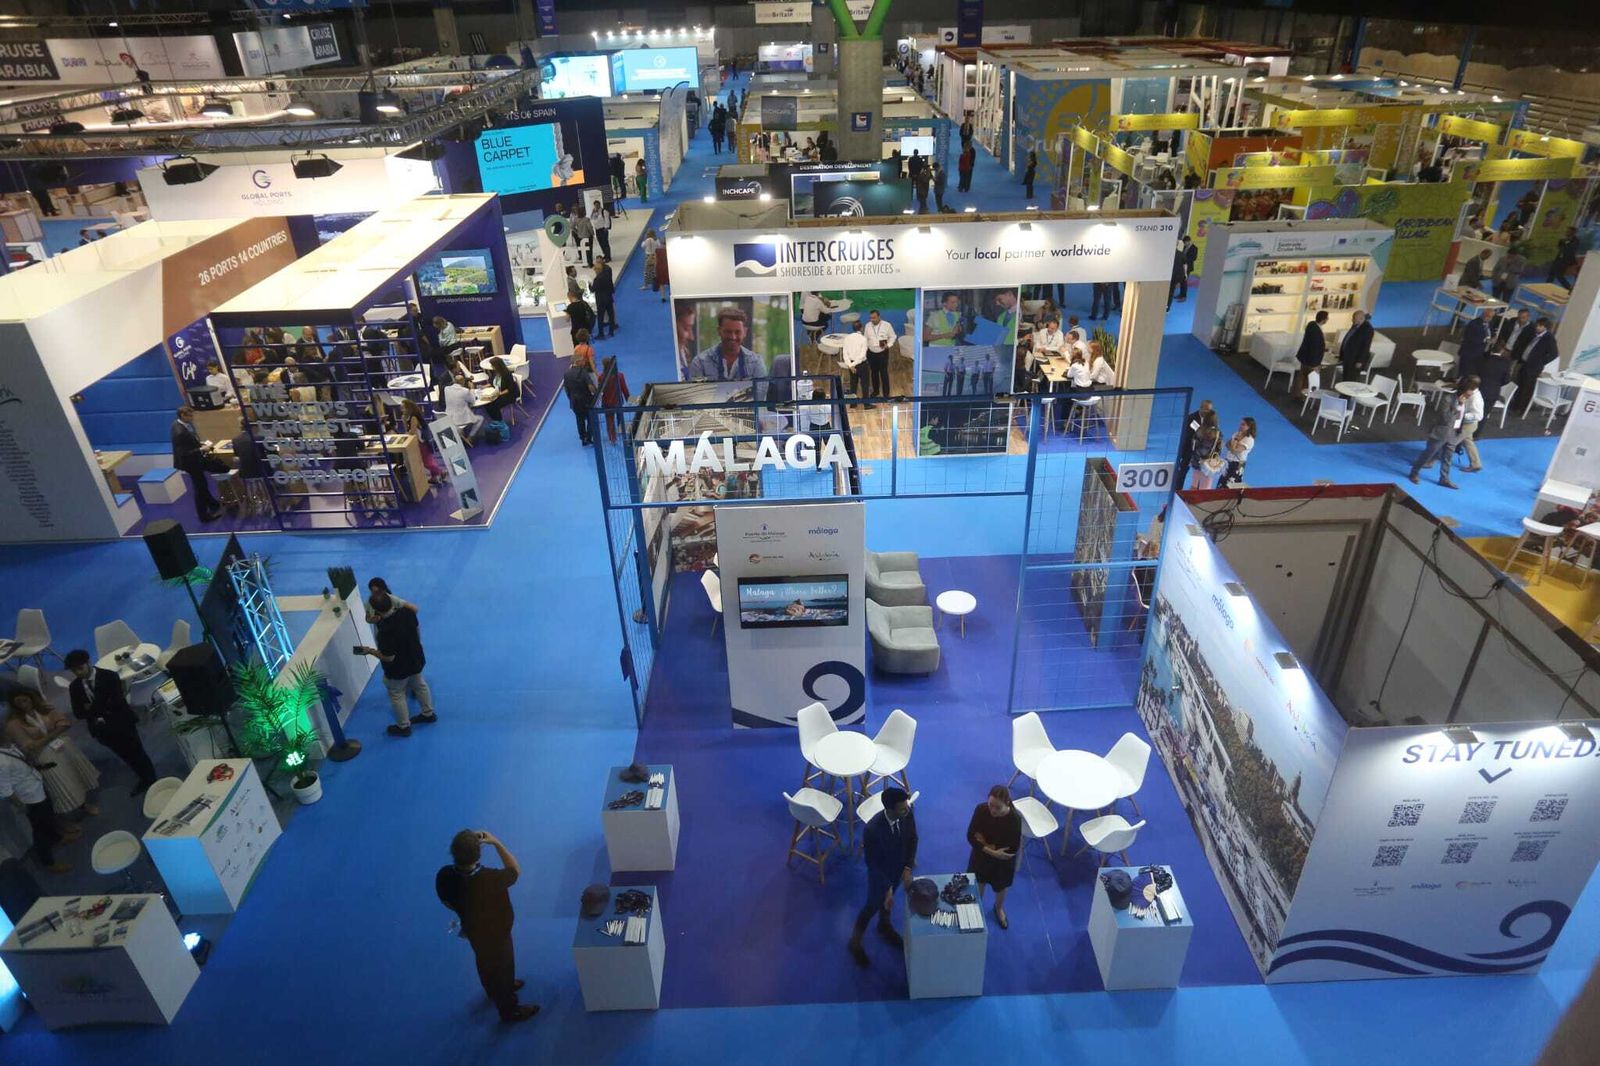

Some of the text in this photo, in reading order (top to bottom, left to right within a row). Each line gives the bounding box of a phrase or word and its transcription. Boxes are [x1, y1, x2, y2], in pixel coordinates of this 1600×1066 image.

[310, 26, 332, 40] CRUISE
[0, 43, 45, 58] RUISE
[315, 44, 336, 57] ARABIA
[533, 108, 557, 118] SPAIN
[481, 135, 513, 150] BLUE
[483, 146, 531, 163] CARPET
[241, 191, 292, 201] GLOBAL PORTS
[722, 187, 756, 195] INCHCAPE
[1135, 224, 1173, 232] STAND 310
[198, 230, 288, 286] 26 PORTS 14 COUNTRIES
[780, 238, 894, 264] INTERCRUISES
[946, 244, 1111, 262] Your local partner worldwide
[780, 265, 825, 278] SHORESIDE
[826, 266, 833, 276] &
[835, 265, 856, 276] PORT
[858, 263, 894, 275] SERVICES
[247, 384, 289, 400] THE
[251, 401, 349, 417] WORLD'S
[256, 418, 351, 436] LARGEST
[263, 435, 337, 451] CRUISE
[266, 453, 324, 469] PORT
[643, 430, 853, 476] MÁLAGA
[272, 468, 384, 485] OPERATOR
[1122, 468, 1169, 488] 300
[1402, 741, 1486, 764] STAY
